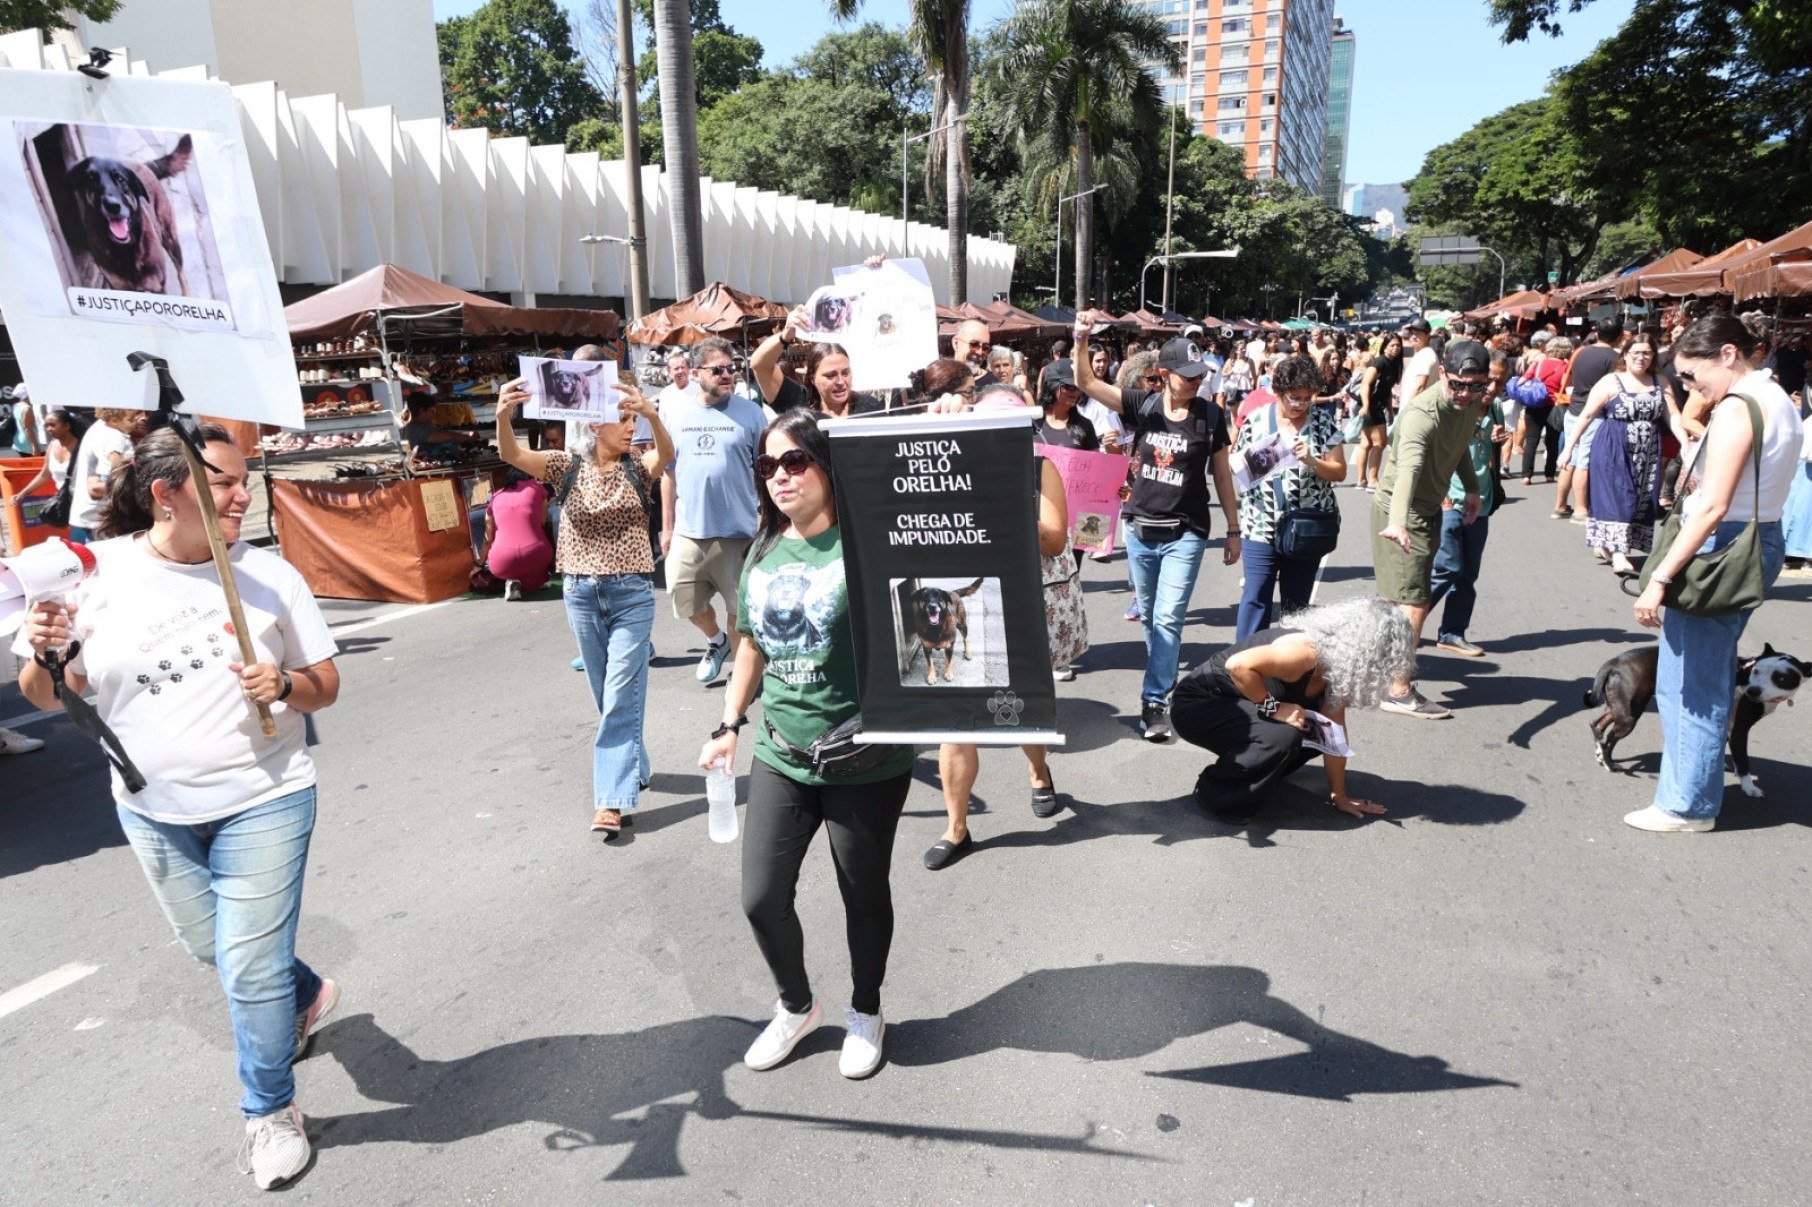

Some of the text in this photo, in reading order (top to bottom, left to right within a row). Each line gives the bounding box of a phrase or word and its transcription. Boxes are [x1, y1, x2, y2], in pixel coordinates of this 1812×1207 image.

[77, 294, 227, 322] #JUSTIÇAPORORELHA
[895, 440, 961, 460] JUSTIÇA
[908, 458, 951, 474] PELO
[893, 474, 972, 493] ORELHA!
[897, 513, 975, 529] CHEGA DE
[889, 530, 991, 545] IMPUNIDADE.
